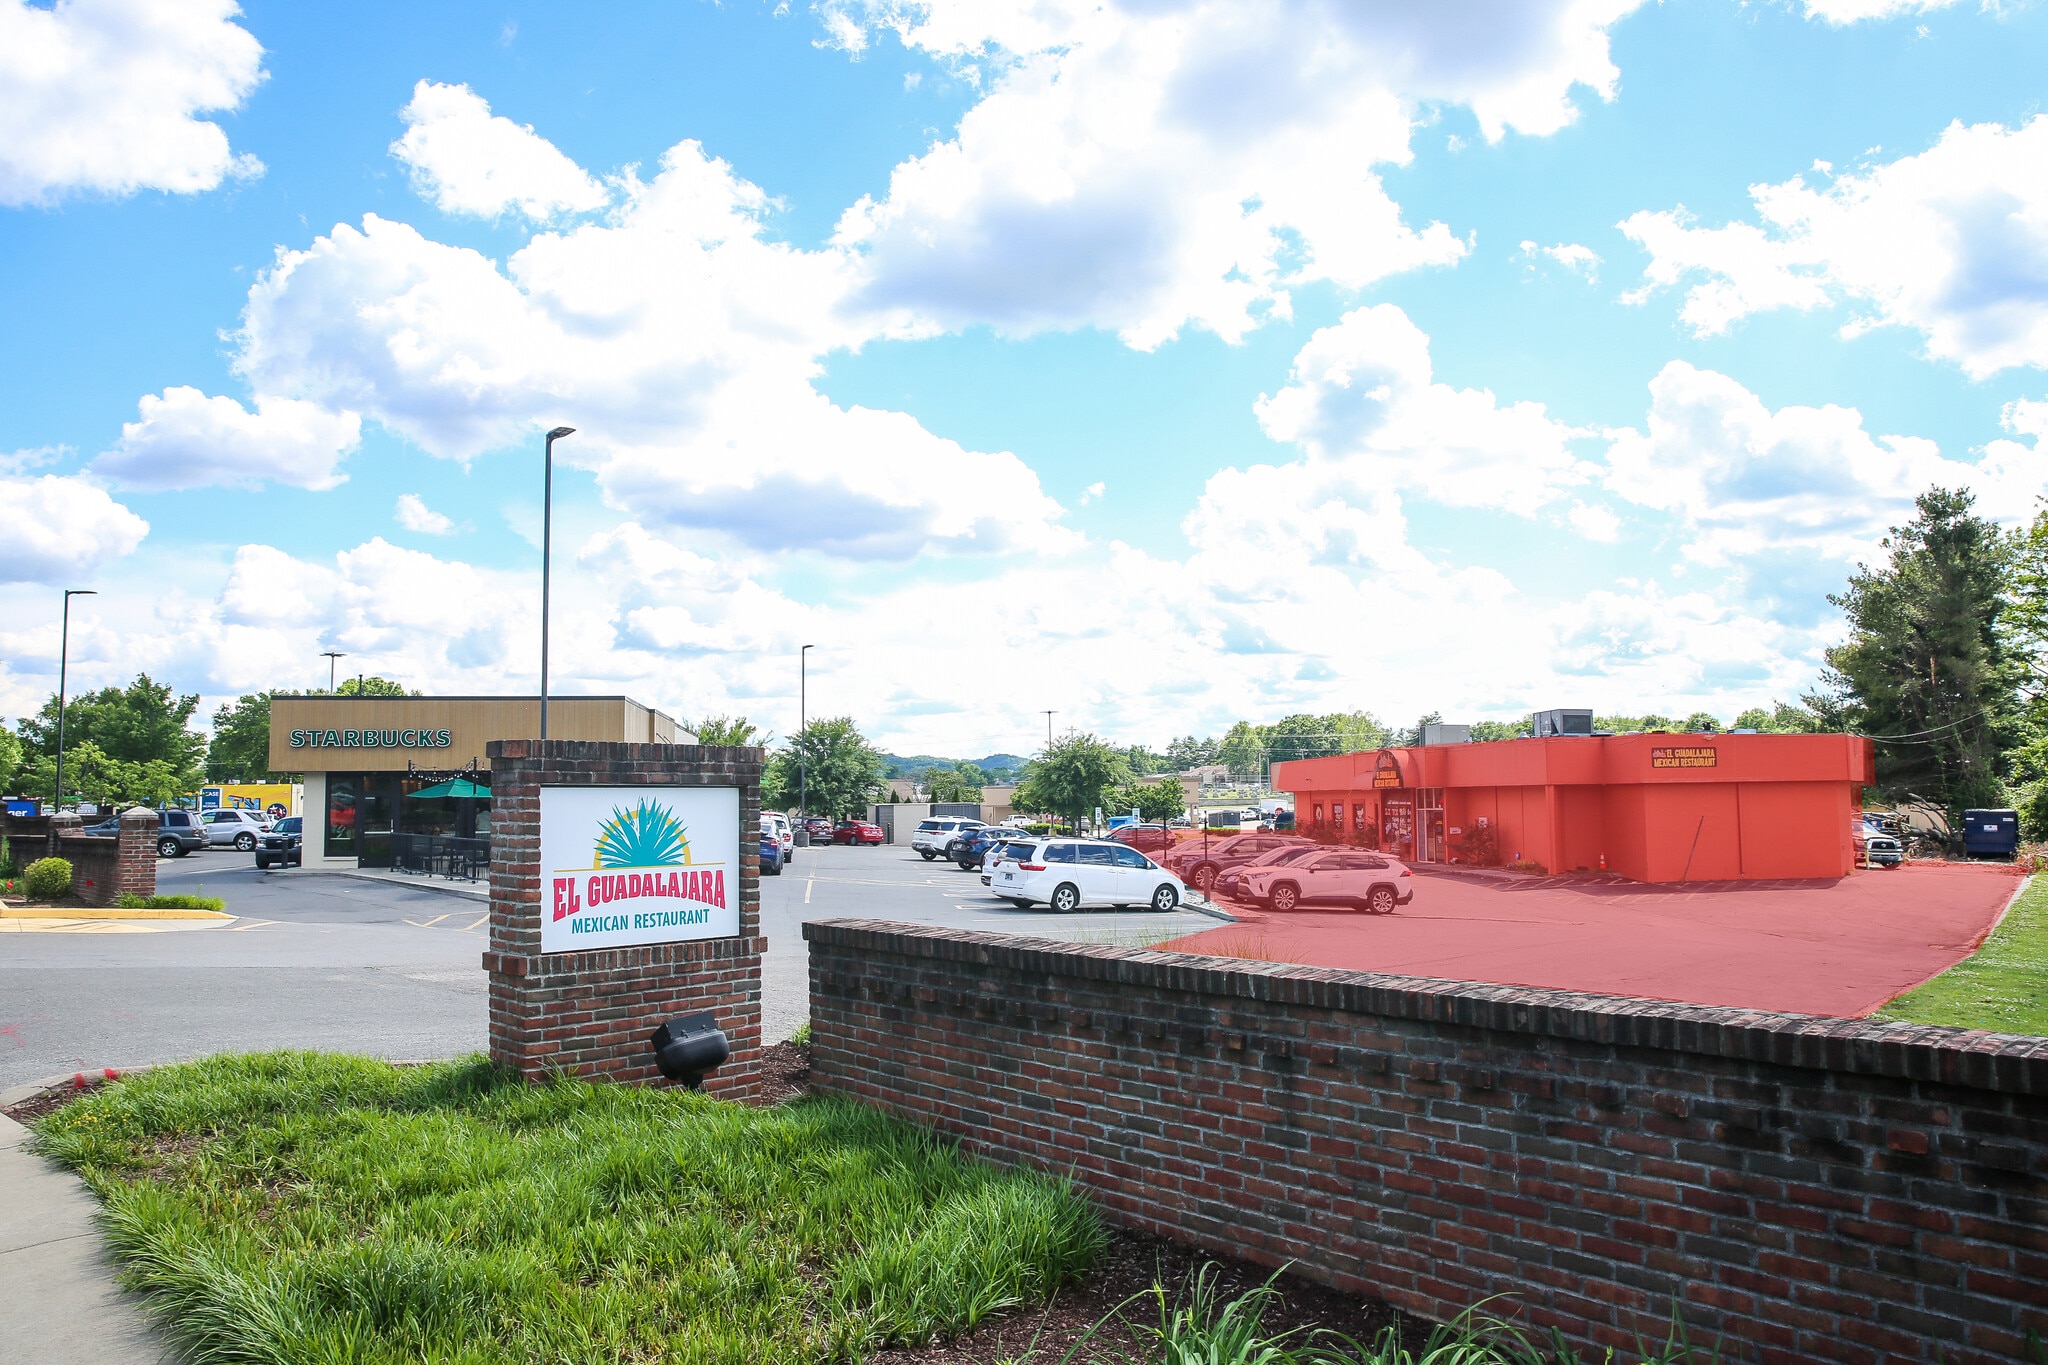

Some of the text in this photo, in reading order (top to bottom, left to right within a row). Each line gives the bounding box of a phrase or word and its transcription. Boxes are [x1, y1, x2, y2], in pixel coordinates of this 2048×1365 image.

[289, 728, 452, 748] STARBUCKS
[1654, 757, 1716, 767] MEXICAN RESTAURANT
[1666, 748, 1715, 758] EL GUADALAJARA
[553, 869, 726, 923] EL GUADALAJARA
[571, 908, 710, 934] MEXICAN RESTAURANT
